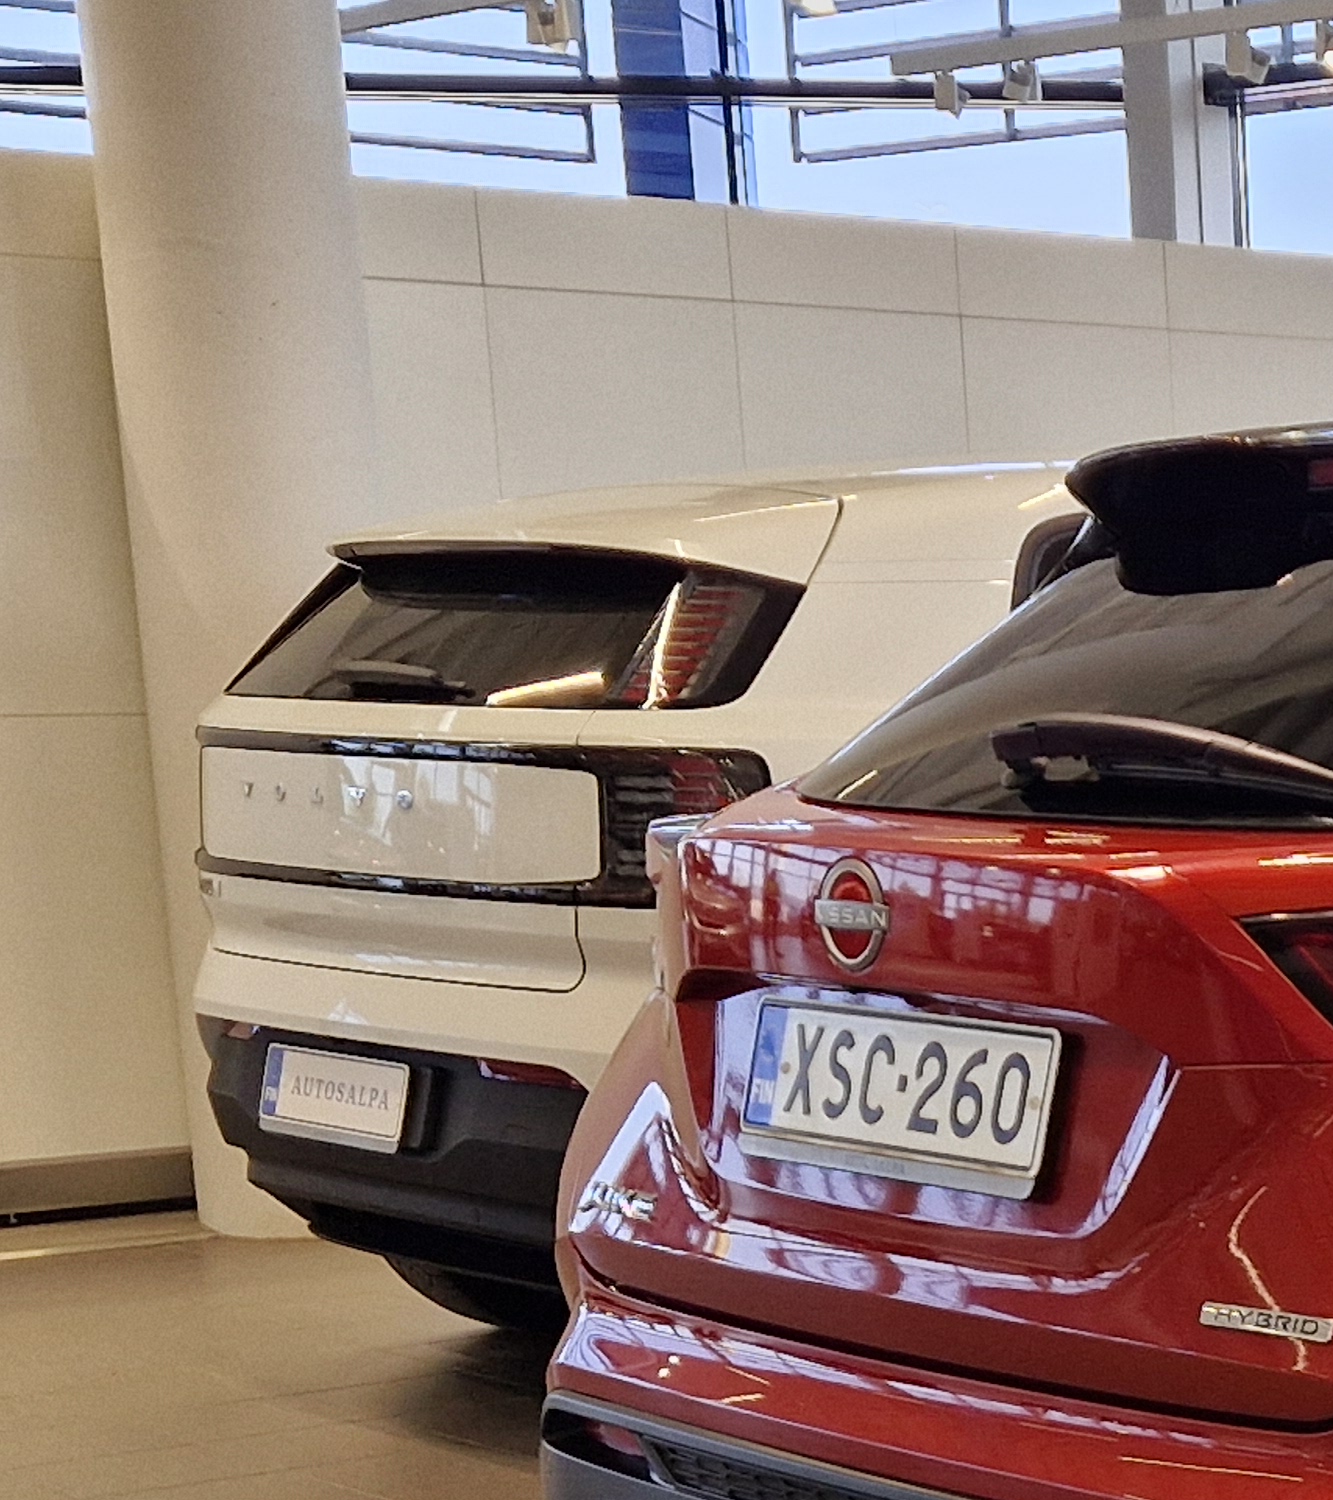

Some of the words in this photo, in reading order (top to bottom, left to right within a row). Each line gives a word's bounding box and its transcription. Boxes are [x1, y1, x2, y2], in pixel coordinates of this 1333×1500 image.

[290, 1075, 390, 1111] AUTOSALPA
[782, 1023, 1032, 1145] XSC-260
[1212, 1306, 1320, 1336] HYBRID
